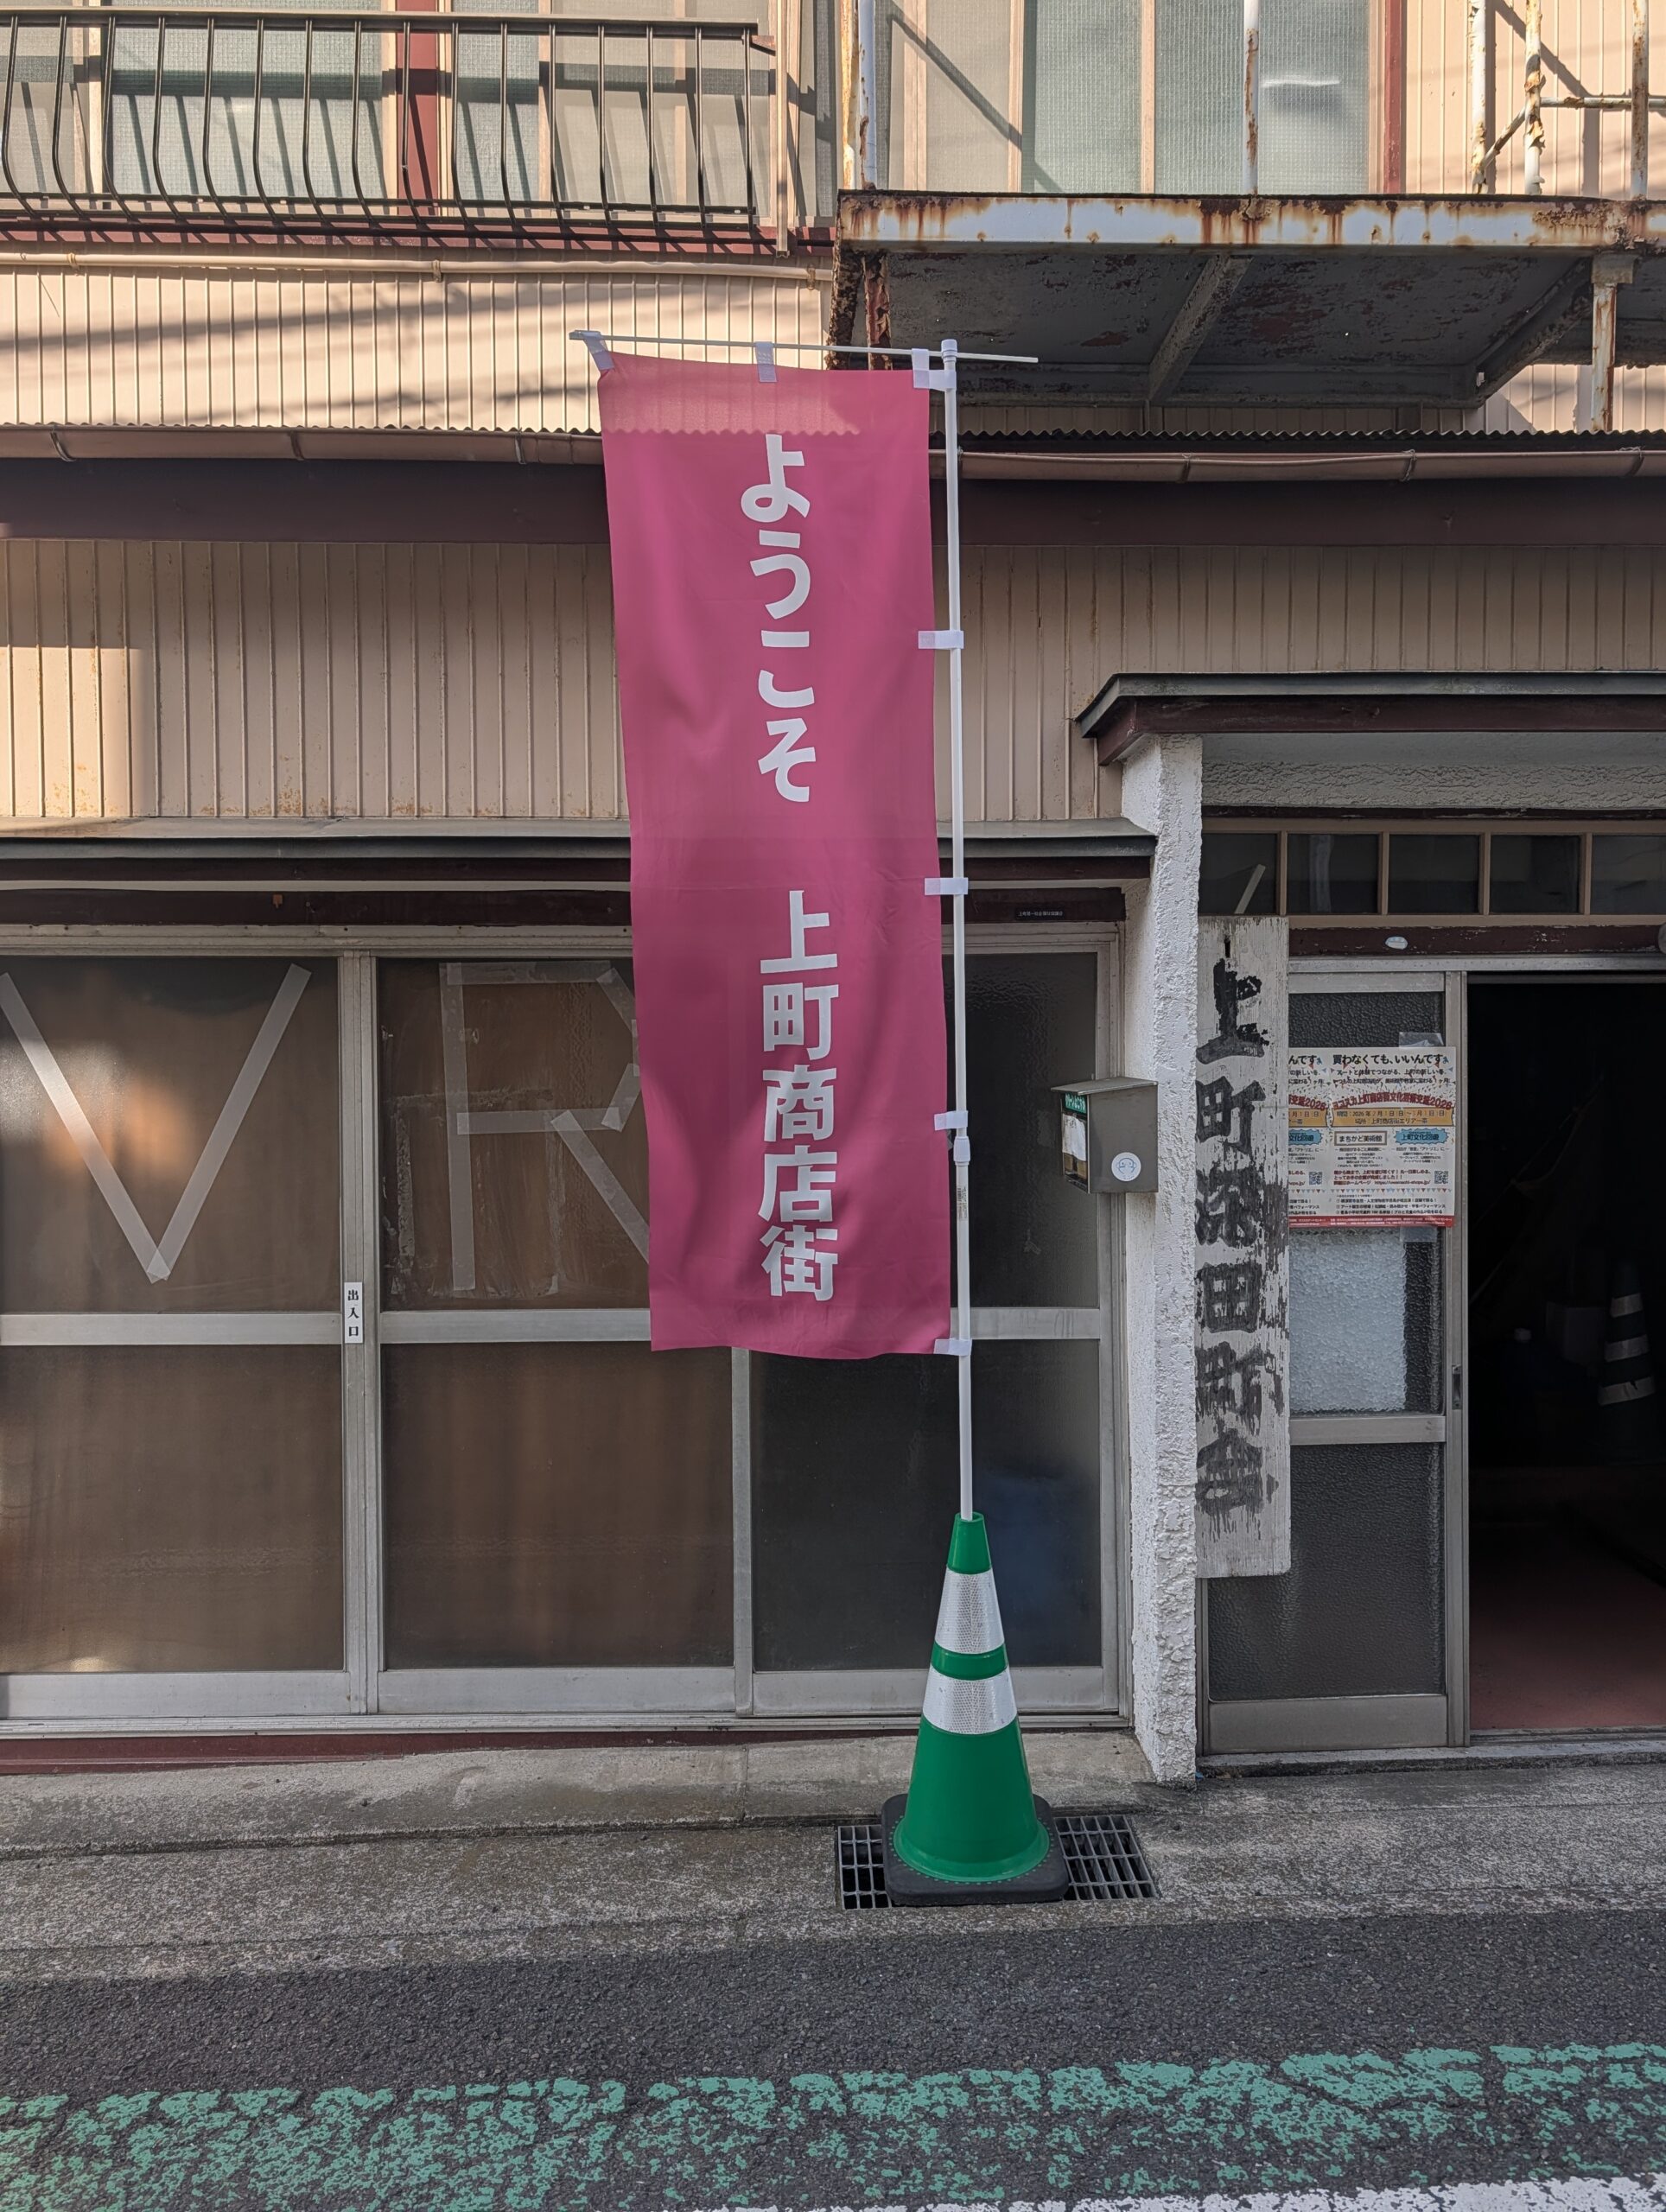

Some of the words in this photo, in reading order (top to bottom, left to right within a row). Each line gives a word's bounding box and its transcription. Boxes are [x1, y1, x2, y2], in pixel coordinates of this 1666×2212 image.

[741, 434, 816, 802] ようこそ
[758, 890, 839, 1301] 上町商店街
[347, 1289, 359, 1337] 出入口
